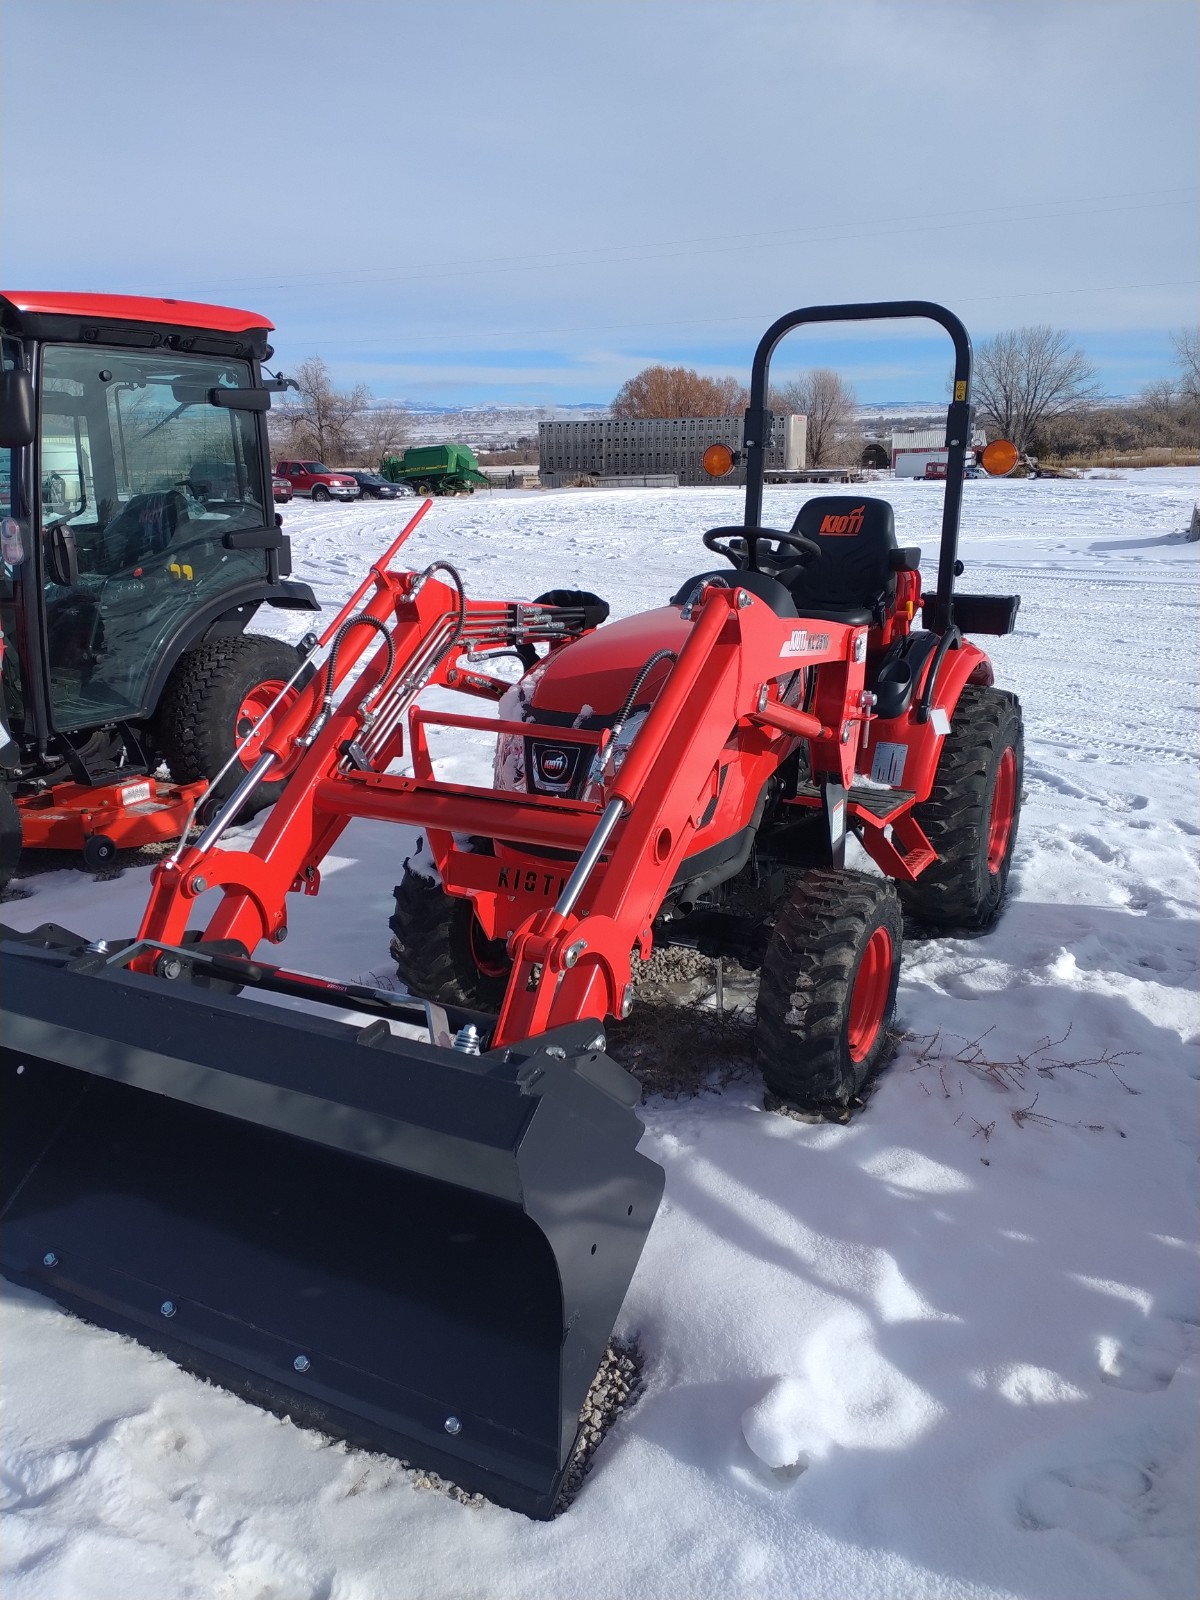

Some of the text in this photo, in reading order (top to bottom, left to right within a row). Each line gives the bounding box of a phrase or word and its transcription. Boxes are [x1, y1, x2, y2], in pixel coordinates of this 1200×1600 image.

[819, 514, 864, 534] KIOTI
[789, 630, 808, 652] KIOTI
[544, 758, 563, 769] KIOTI
